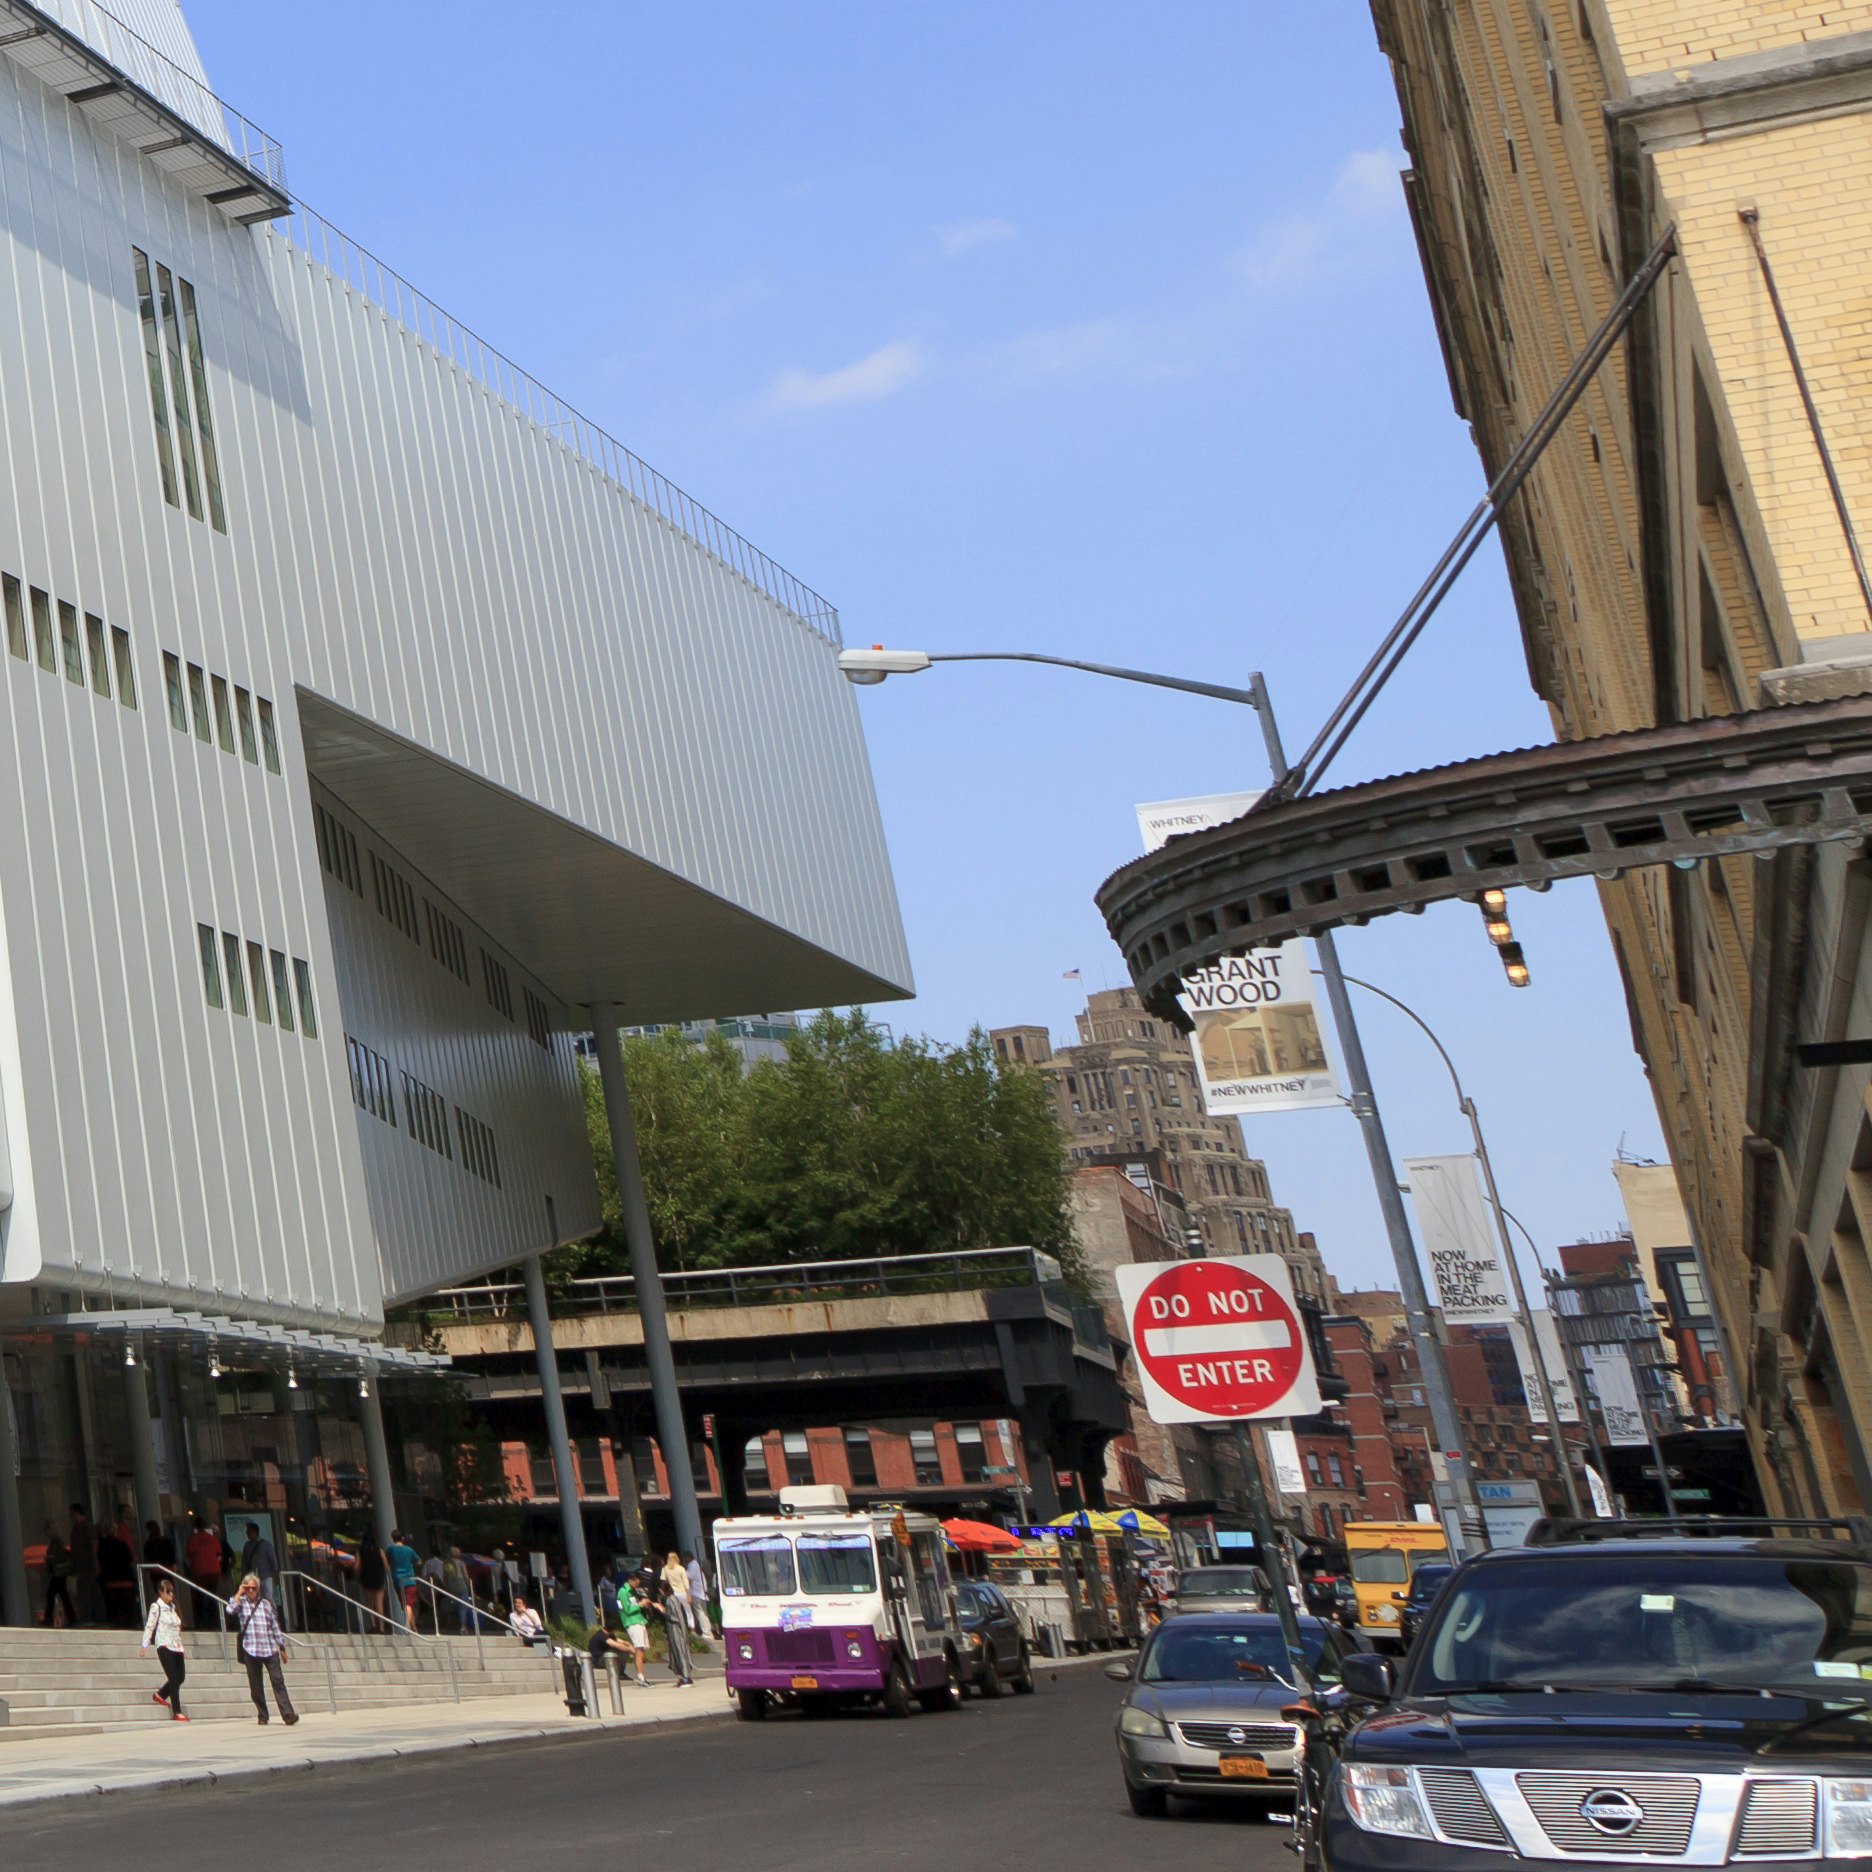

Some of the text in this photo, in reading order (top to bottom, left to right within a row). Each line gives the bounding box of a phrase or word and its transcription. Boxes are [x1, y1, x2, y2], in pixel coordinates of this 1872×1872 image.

[1150, 814, 1204, 828] WHITNEY
[1185, 980, 1281, 1007] WOOD
[1211, 1079, 1306, 1097] #NEWWHITNEY
[1431, 1250, 1466, 1261] NOW
[1435, 1259, 1498, 1272] AT HOME
[1437, 1271, 1485, 1284] IN THE
[1439, 1283, 1479, 1296] MEAT
[1149, 1288, 1263, 1320] DO NOT
[1443, 1294, 1508, 1307] PACKING
[1177, 1358, 1275, 1388] ENTER
[1587, 1807, 1635, 1816] NISSAN
